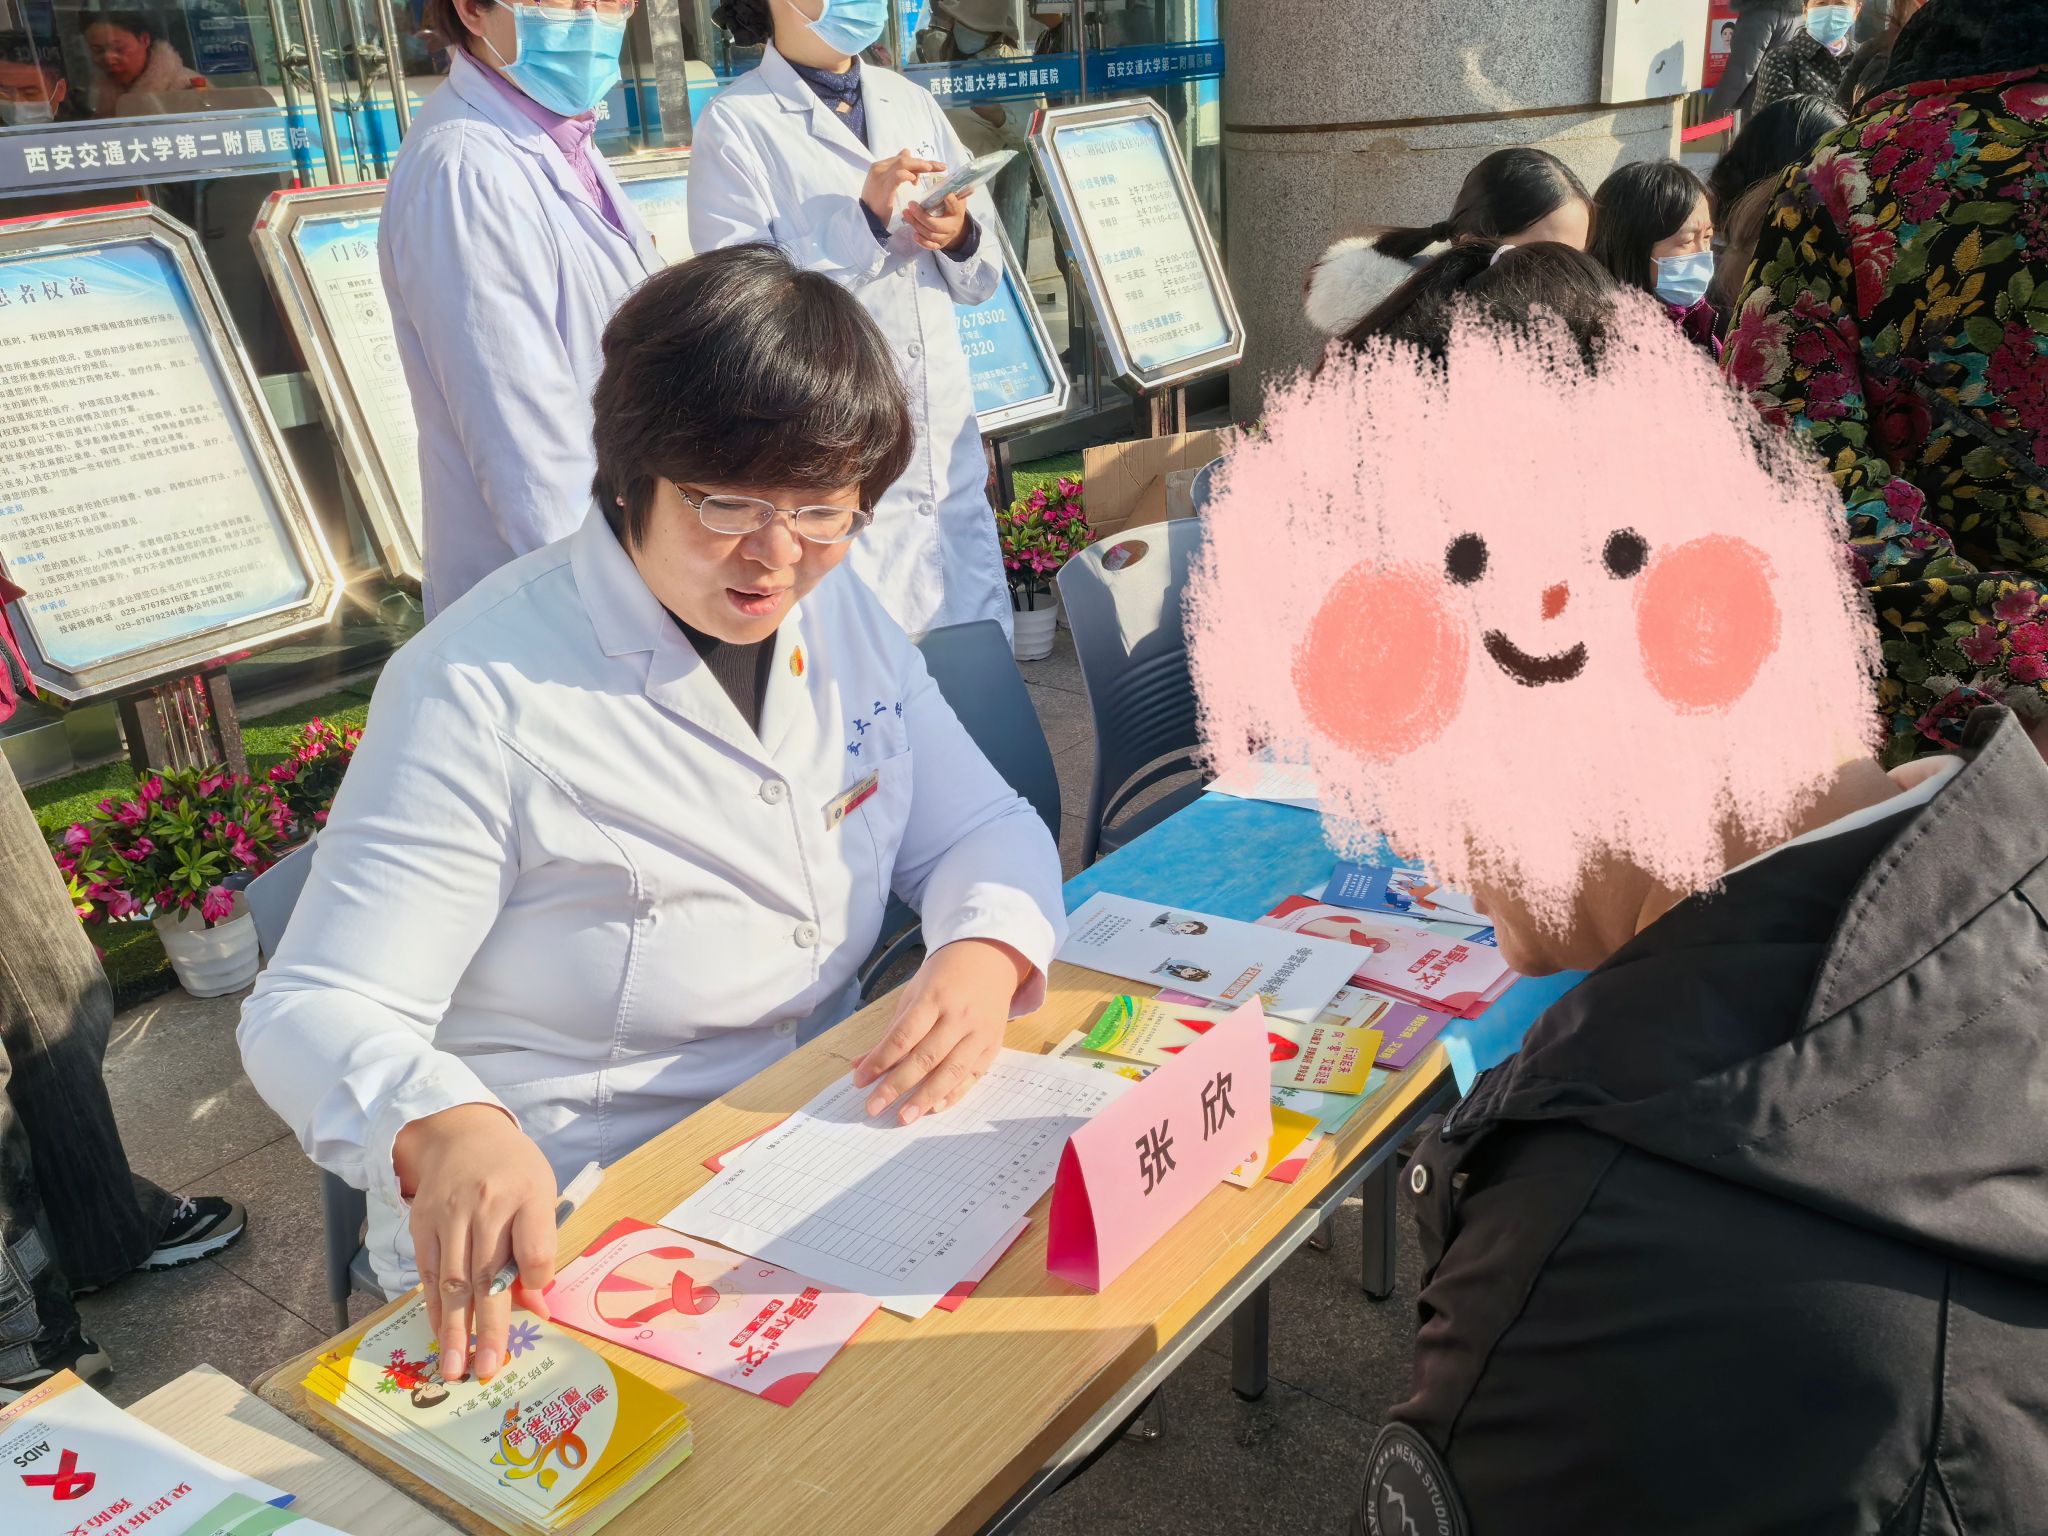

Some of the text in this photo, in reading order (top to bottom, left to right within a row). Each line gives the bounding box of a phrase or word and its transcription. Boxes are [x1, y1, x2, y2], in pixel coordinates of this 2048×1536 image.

[929, 68, 1060, 95] 西安交通大学第二附属医院
[1107, 53, 1213, 78] 西安交通大学第二附属医院
[23, 127, 310, 174] 西安交通大学第二附属医院
[331, 240, 380, 263] 门诊
[1135, 1072, 1236, 1197] 张 欣
[735, 1286, 823, 1378] 要爱不要“艾”
[449, 1370, 518, 1418] 健康全家人
[487, 1356, 555, 1411] 预防艾滋病
[506, 1386, 581, 1448] 履行承诺
[535, 1384, 610, 1446] 遏制艾滋
[13, 1440, 51, 1469] AIDS
[1396, 1443, 1450, 1536] MEN'S STUDIO
